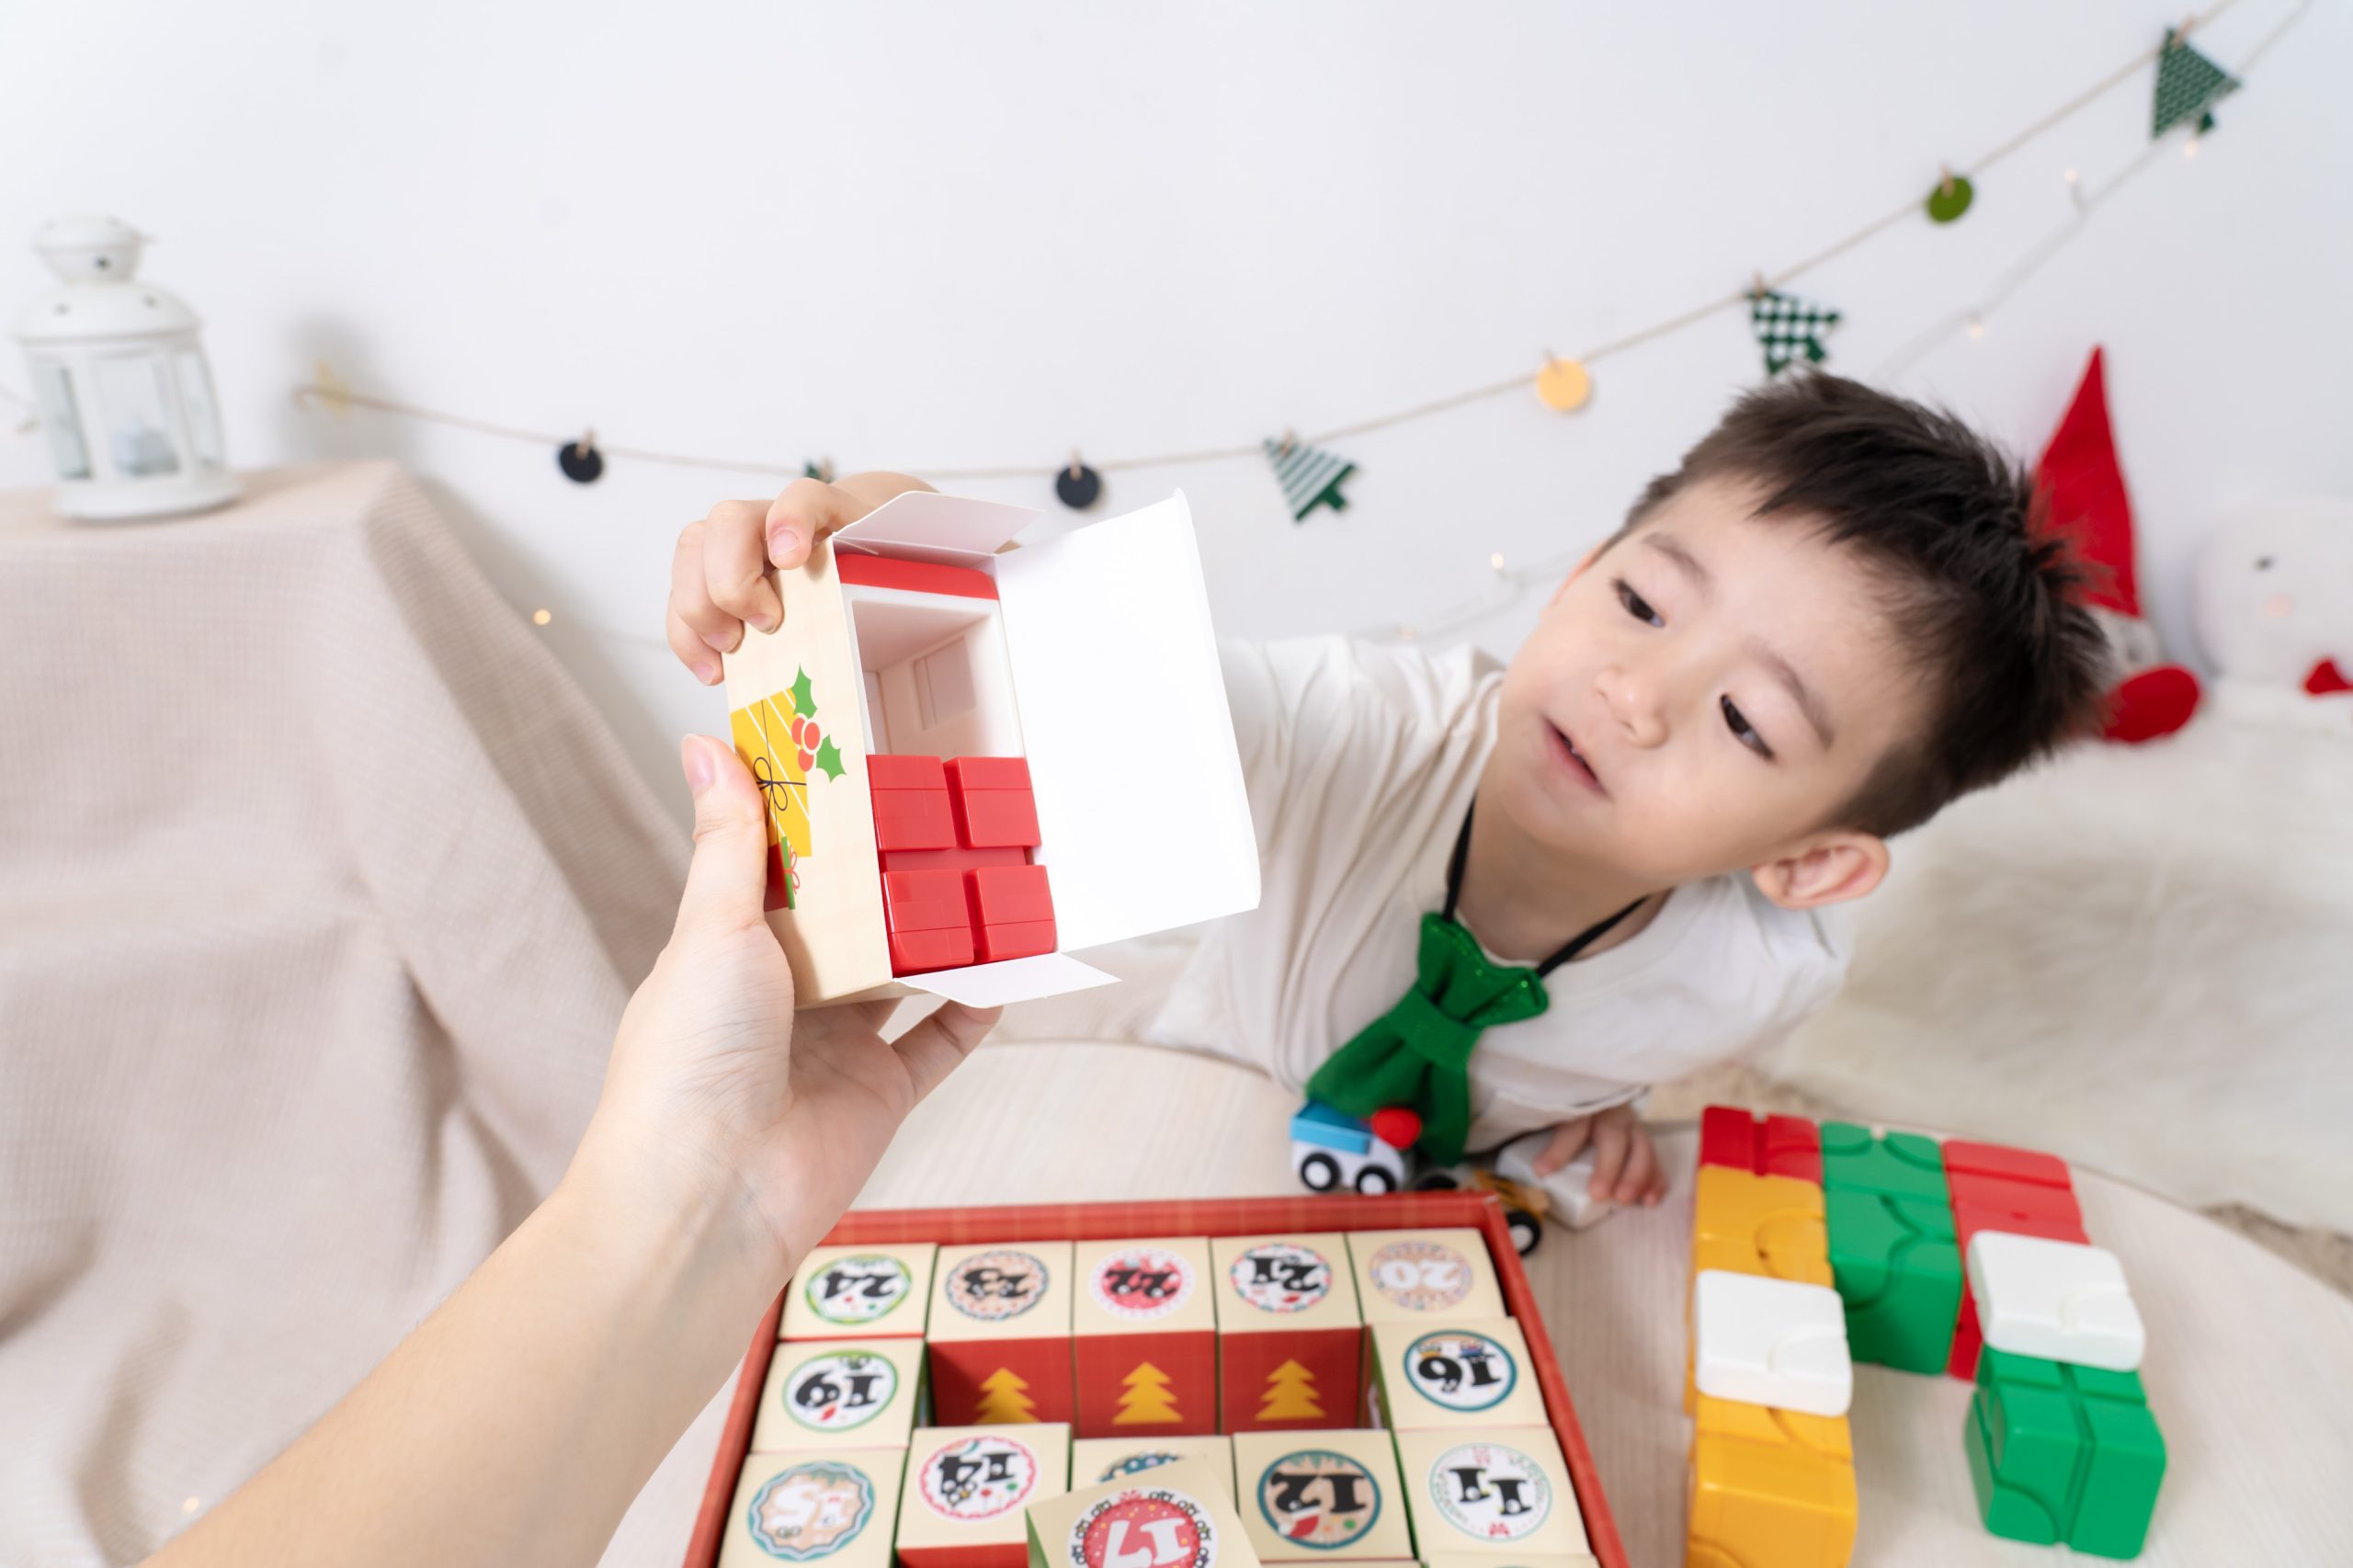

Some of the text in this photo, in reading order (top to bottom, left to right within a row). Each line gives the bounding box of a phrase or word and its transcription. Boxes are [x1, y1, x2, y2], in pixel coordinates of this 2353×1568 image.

[824, 1269, 900, 1301] 24
[961, 1267, 1031, 1301] 23
[1104, 1269, 1177, 1298] 22
[1247, 1256, 1324, 1292] 21
[1381, 1260, 1460, 1289] 20
[794, 1369, 885, 1408] 19
[1417, 1352, 1502, 1392] 16
[938, 1451, 1019, 1494] 14
[1448, 1467, 1532, 1516] 11
[772, 1483, 847, 1531] 15
[1268, 1471, 1369, 1514] 12
[1103, 1517, 1191, 1568] 17
